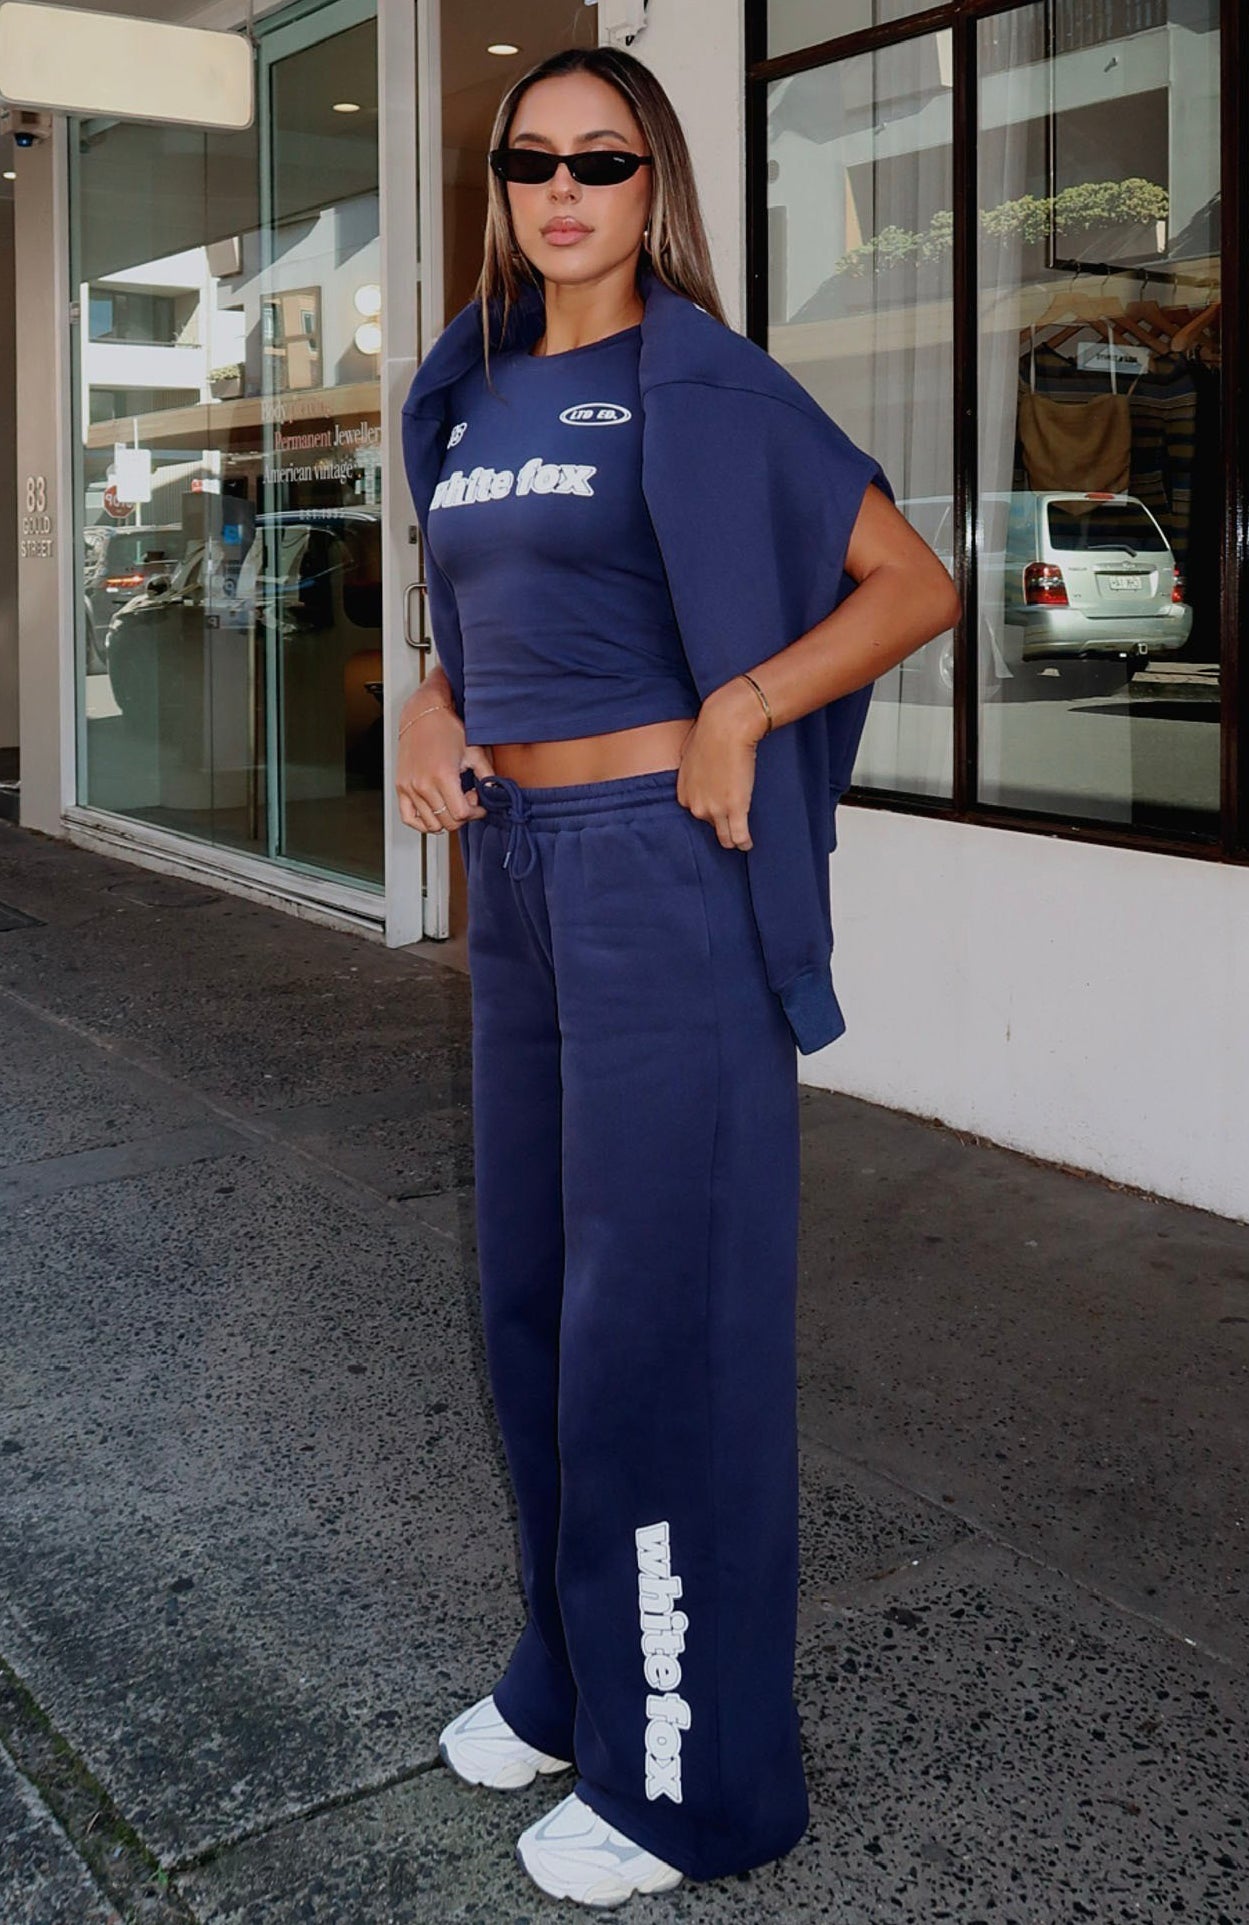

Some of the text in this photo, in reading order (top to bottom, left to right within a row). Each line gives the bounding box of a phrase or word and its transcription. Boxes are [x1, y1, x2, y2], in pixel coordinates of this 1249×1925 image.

[569, 408, 618, 420] LTD ED.
[274, 430, 331, 451] Permanent
[263, 460, 353, 485] American vintage
[515, 457, 597, 497] fox
[26, 476, 46, 513] 83
[21, 540, 52, 558] STREET
[635, 1521, 692, 1804] white fox
